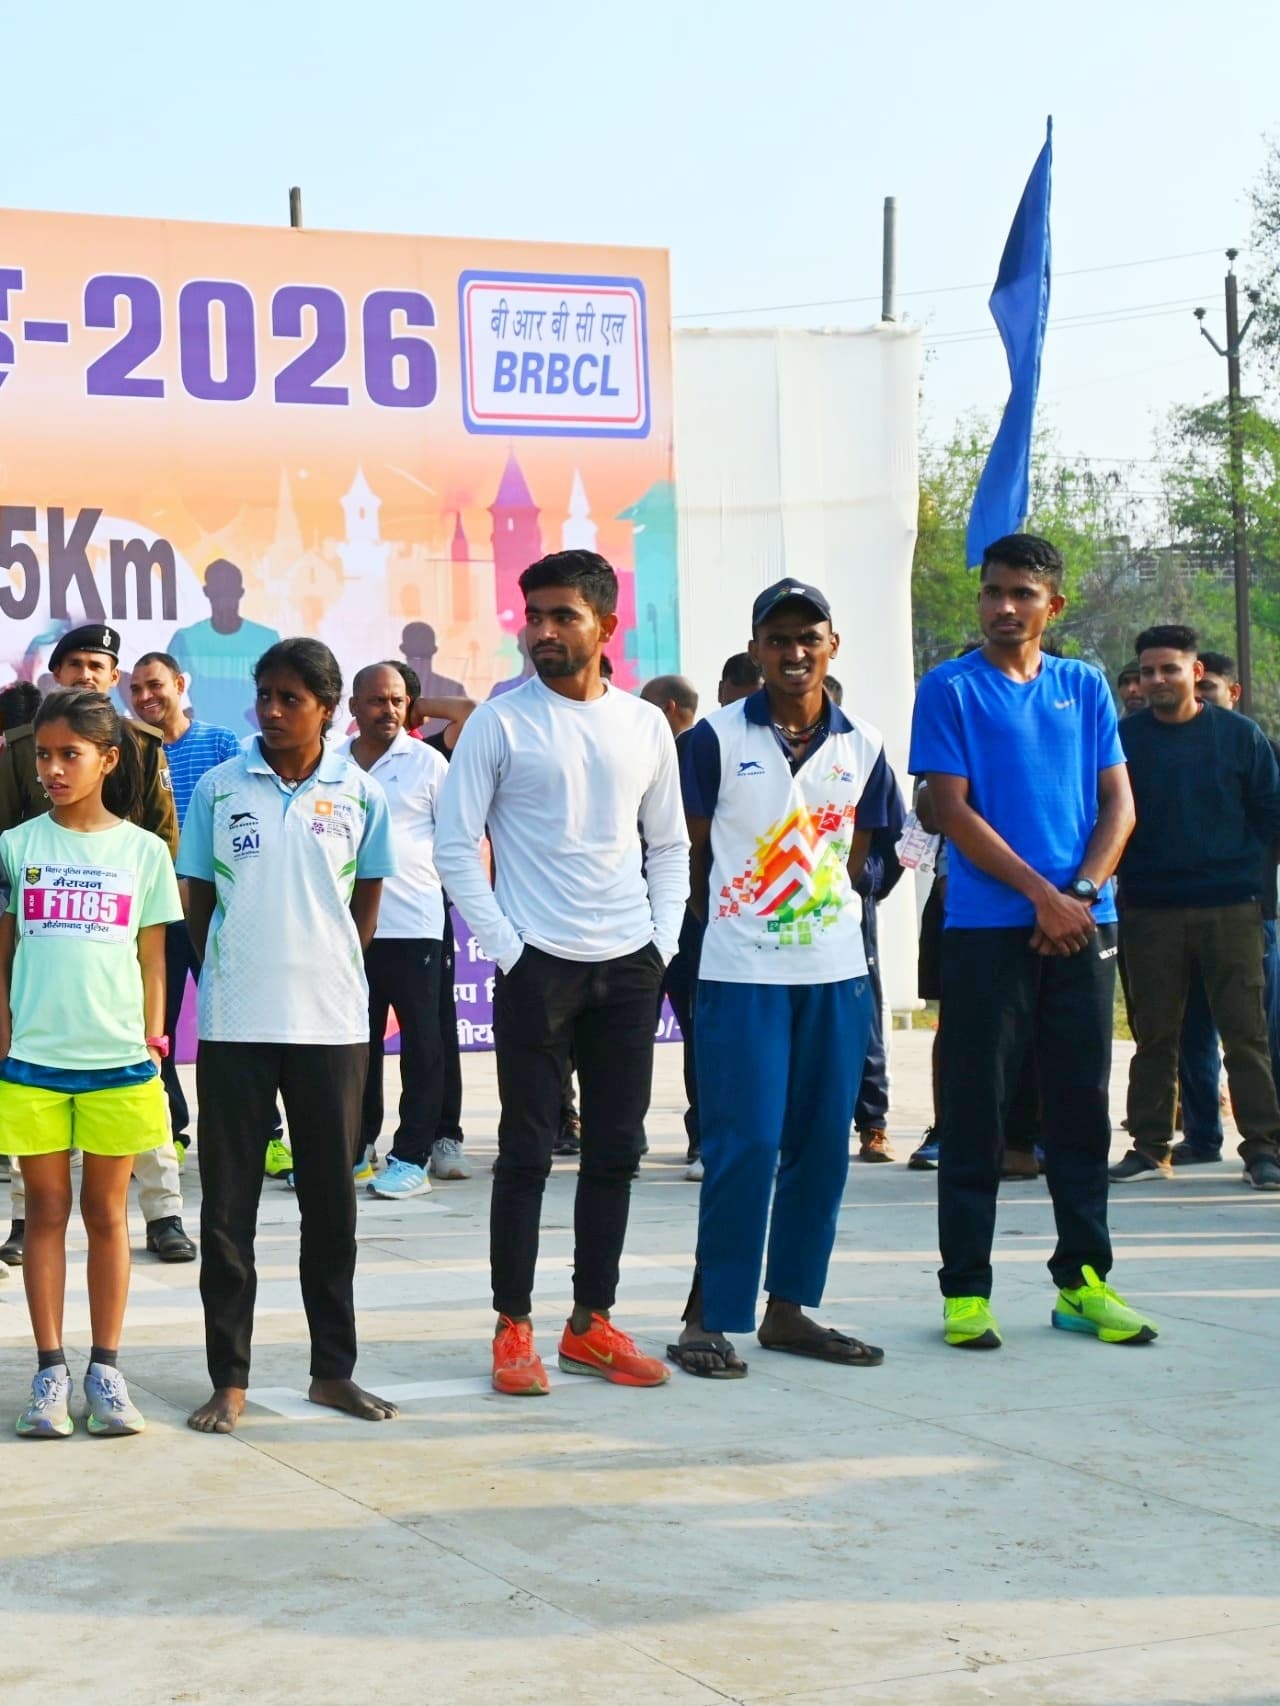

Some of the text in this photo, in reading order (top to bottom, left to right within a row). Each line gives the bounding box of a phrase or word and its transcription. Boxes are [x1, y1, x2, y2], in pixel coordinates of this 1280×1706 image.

[490, 297, 627, 347] बी आर बी सी एल
[492, 350, 621, 397] BRBCL
[232, 833, 260, 853] SAI
[43, 889, 118, 923] F1185
